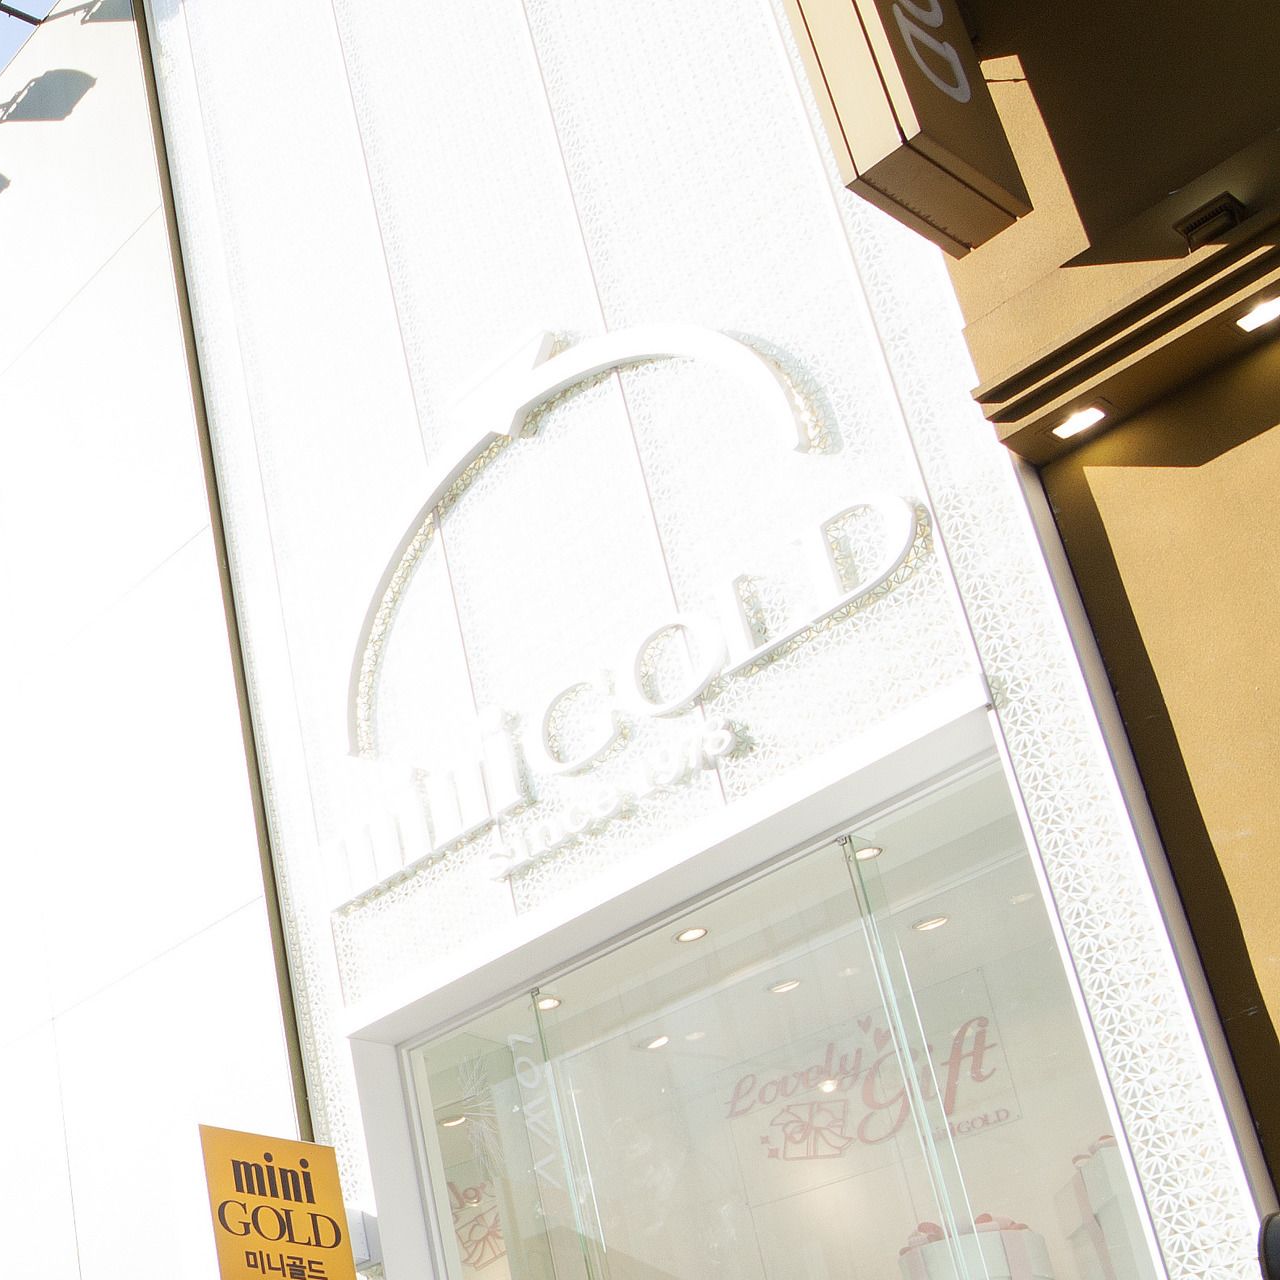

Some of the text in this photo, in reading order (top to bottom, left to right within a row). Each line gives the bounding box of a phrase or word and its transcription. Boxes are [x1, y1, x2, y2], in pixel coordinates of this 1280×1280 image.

[231, 1152, 316, 1205] mini
[217, 1199, 342, 1249] GOLD
[245, 1250, 328, 1280] 미니골드
